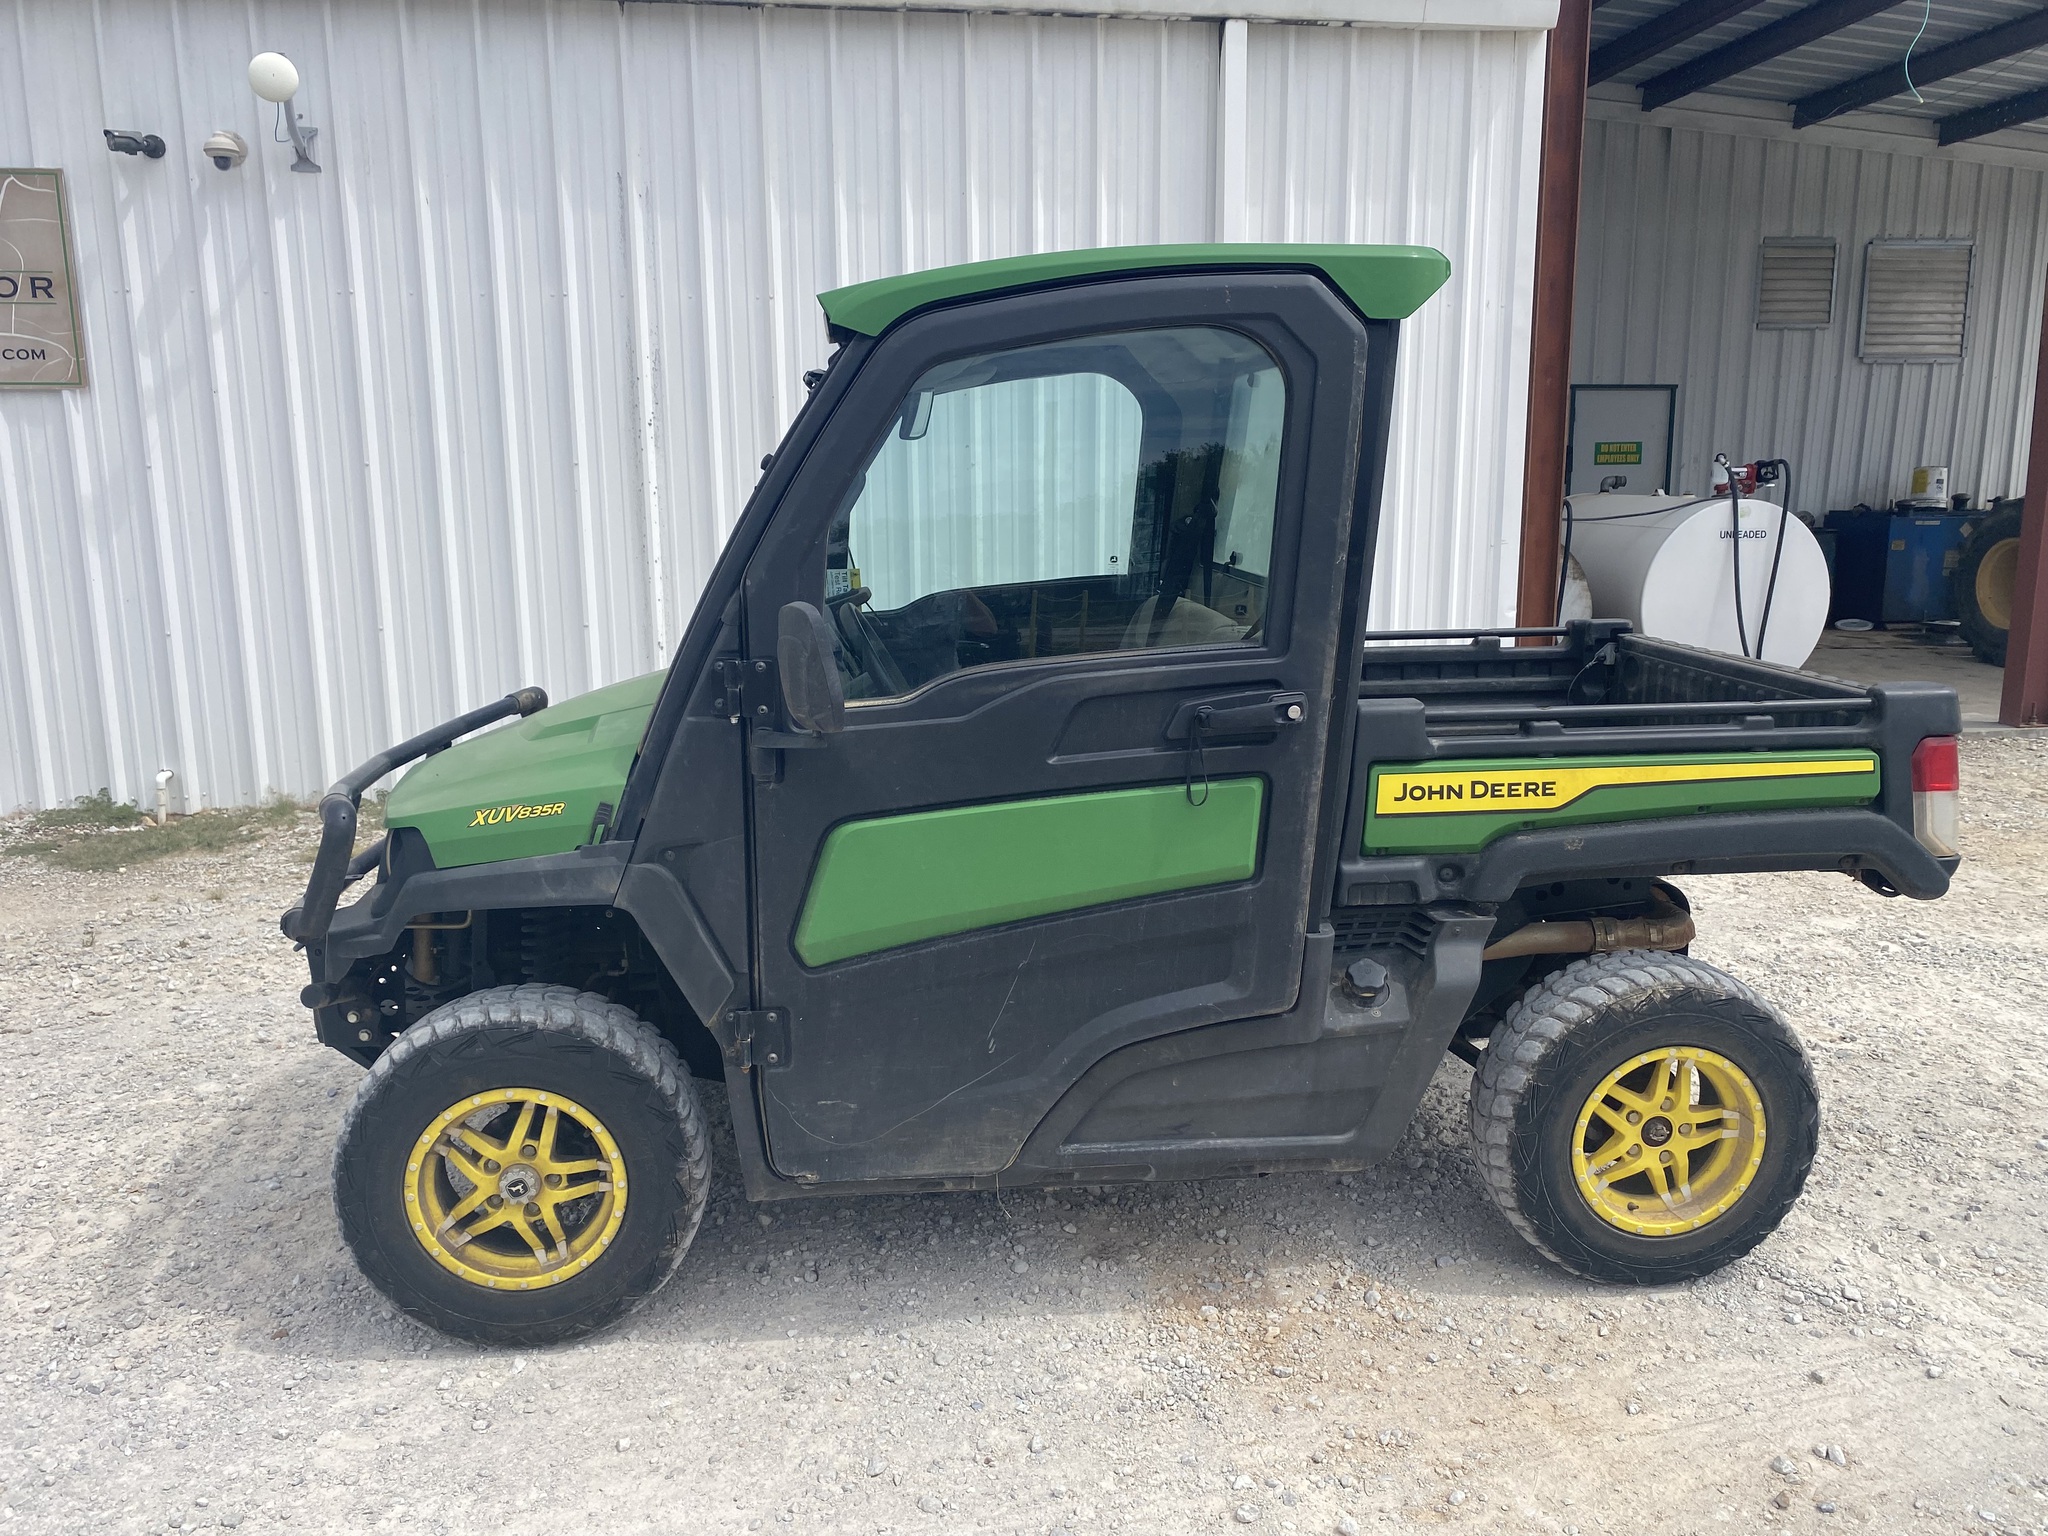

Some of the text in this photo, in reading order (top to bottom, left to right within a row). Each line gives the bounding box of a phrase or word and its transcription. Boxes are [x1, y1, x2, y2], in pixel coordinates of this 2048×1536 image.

[1609, 444, 1620, 452] NOT
[1620, 444, 1636, 452] ENTER
[1597, 454, 1626, 463] EMPLOYEES
[1393, 780, 1556, 801] JOHN DEERE
[467, 801, 566, 828] XUV835R
